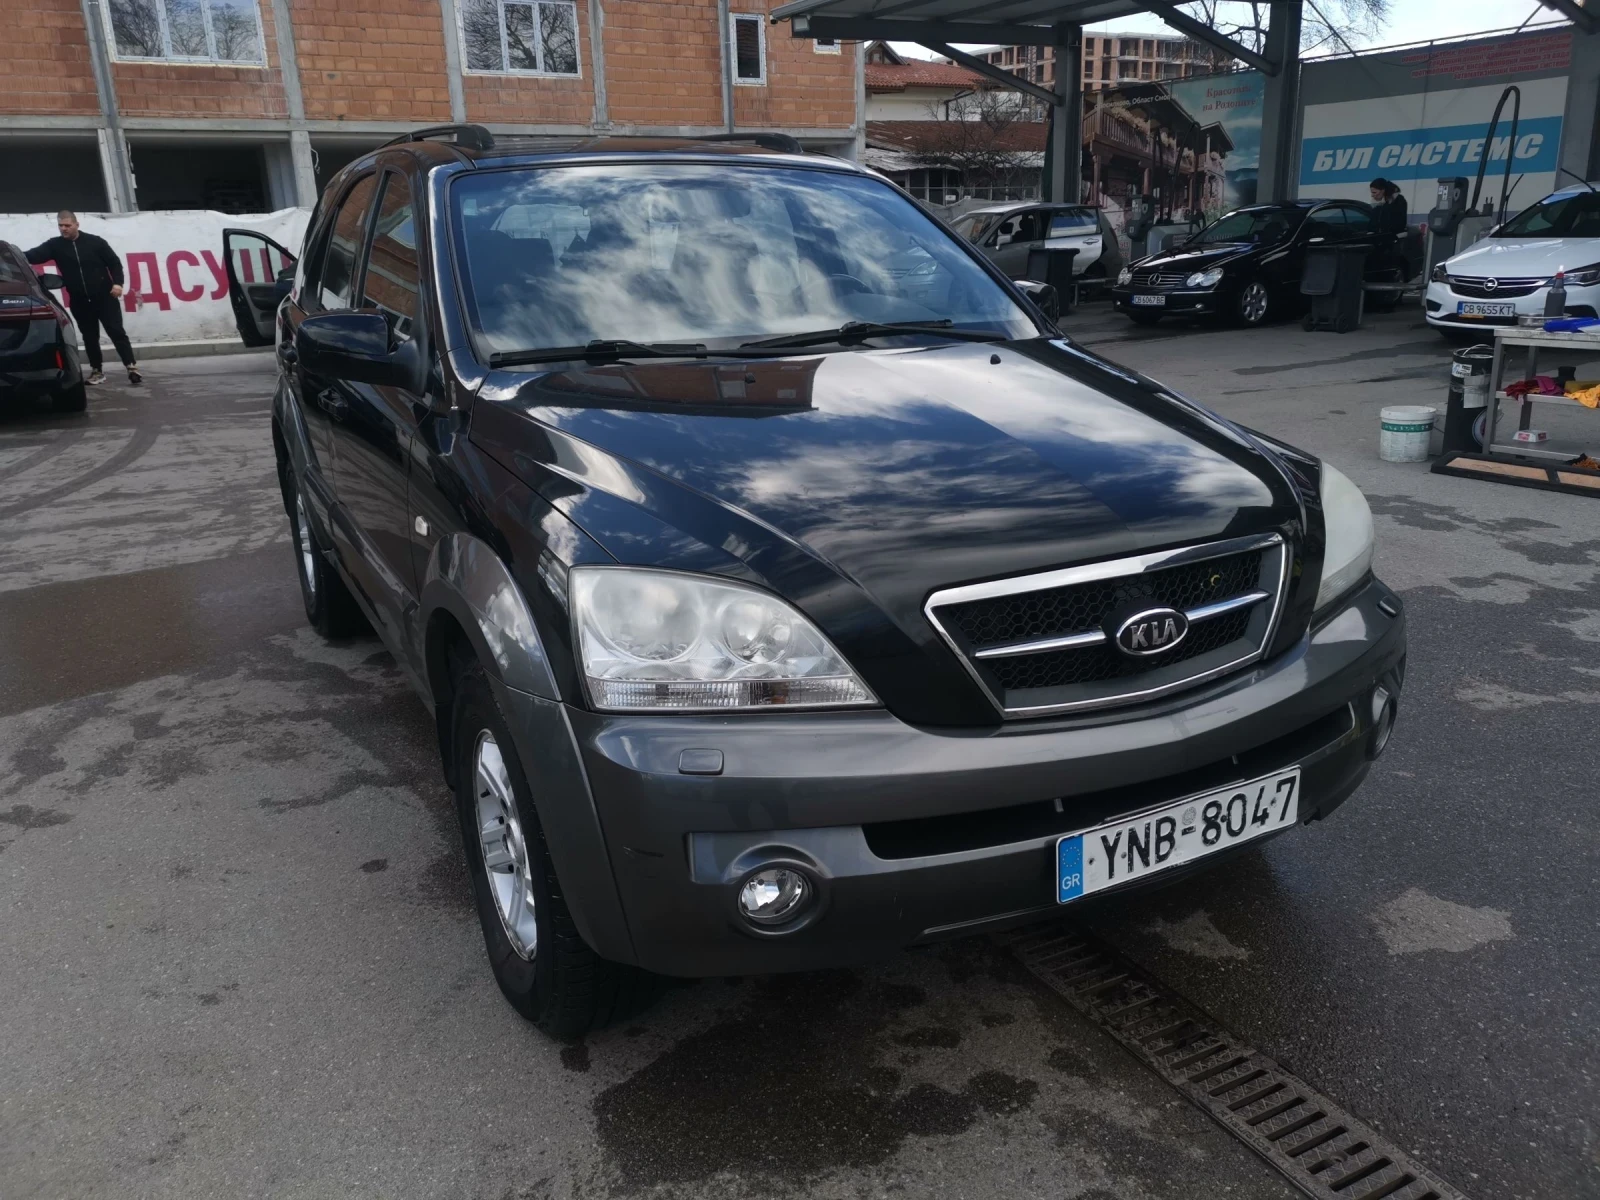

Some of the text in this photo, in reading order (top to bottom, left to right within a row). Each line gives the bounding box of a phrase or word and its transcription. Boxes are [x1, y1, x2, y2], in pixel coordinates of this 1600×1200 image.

[1132, 97, 1154, 105] Област
[1312, 133, 1544, 172] БУЛ СИСТЕМС
[1476, 305, 1498, 315] 9655
[1499, 306, 1512, 315] KT
[1130, 618, 1179, 648] KIA
[1062, 873, 1081, 890] GR
